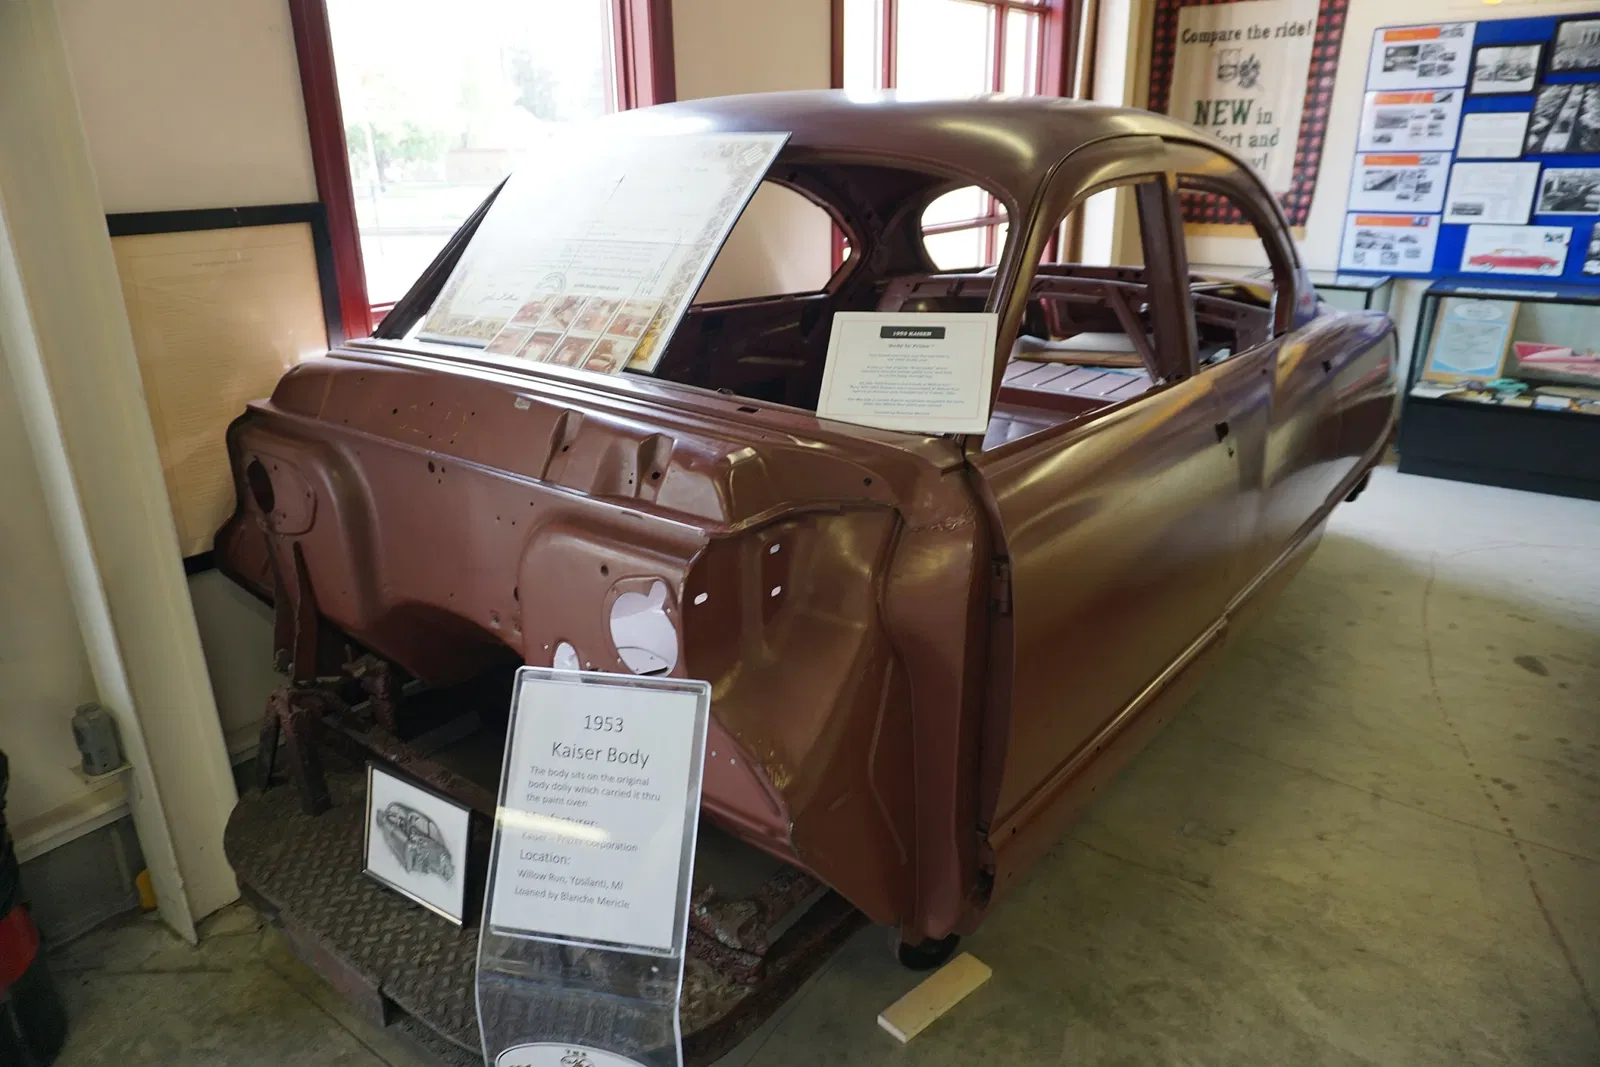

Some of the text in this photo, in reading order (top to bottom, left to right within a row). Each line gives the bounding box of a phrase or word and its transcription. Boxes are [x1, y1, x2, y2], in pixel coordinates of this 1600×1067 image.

[1181, 20, 1312, 47] Compare the ride!
[1193, 99, 1272, 126] NEW in
[1248, 127, 1280, 147] and
[584, 715, 624, 732] 1953
[552, 741, 649, 769] Kaiser Body
[531, 766, 649, 787] The body sits on the original
[527, 793, 541, 802] the
[542, 796, 564, 805] paint
[528, 780, 660, 801] body dolly which carried it thru
[520, 849, 571, 865] Location:
[518, 869, 547, 880] Willow
[515, 886, 547, 898] Loaned
[548, 891, 559, 901] by
[561, 892, 595, 904] Blanche
